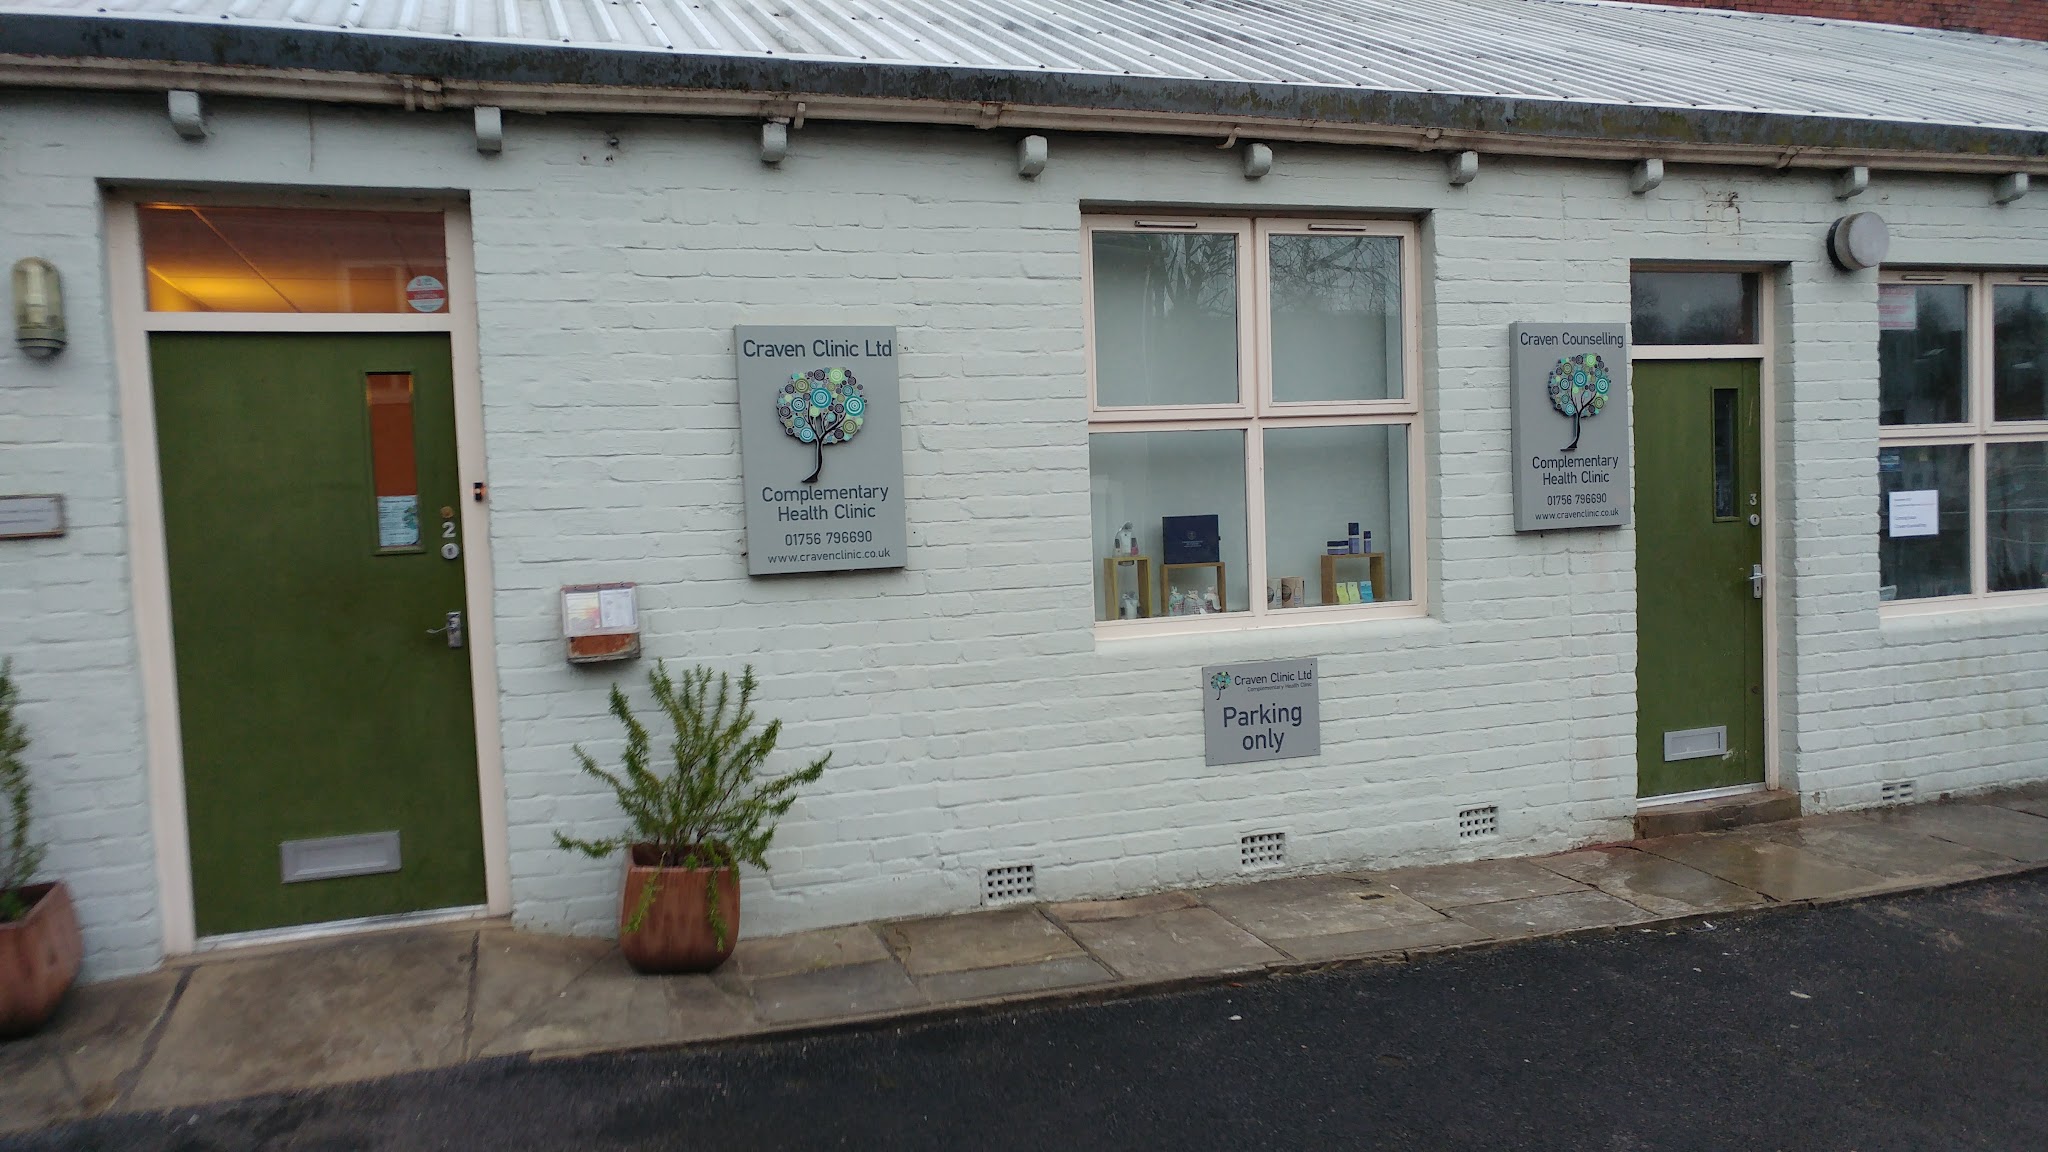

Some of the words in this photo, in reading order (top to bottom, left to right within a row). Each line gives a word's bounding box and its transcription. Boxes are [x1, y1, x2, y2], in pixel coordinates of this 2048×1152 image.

[1520, 331, 1559, 346] Craven
[1562, 331, 1624, 348] Counselling
[743, 339, 806, 358] Craven
[812, 339, 860, 358] Clinic
[865, 339, 893, 357] Ltd
[1532, 455, 1619, 471] Complementary
[1542, 471, 1578, 486] Health
[1581, 470, 1610, 485] Clinic
[762, 485, 889, 505] Complementary
[1547, 494, 1573, 506] 01756
[1575, 492, 1608, 505] 796690
[1749, 493, 1757, 505] 3
[778, 504, 829, 522] Health
[834, 503, 876, 520] Clinic
[1535, 508, 1619, 520] www.cravenclinic.co.uk
[442, 521, 457, 539] 2
[785, 531, 822, 546] 01756
[826, 530, 873, 545] 796690
[767, 548, 891, 564] www.cravenclinic.co.uk
[1234, 675, 1268, 686] Craven
[1270, 671, 1295, 683] Clinic
[1297, 669, 1312, 681] Ltd
[1223, 703, 1302, 728] Parking
[1242, 728, 1285, 753] only
